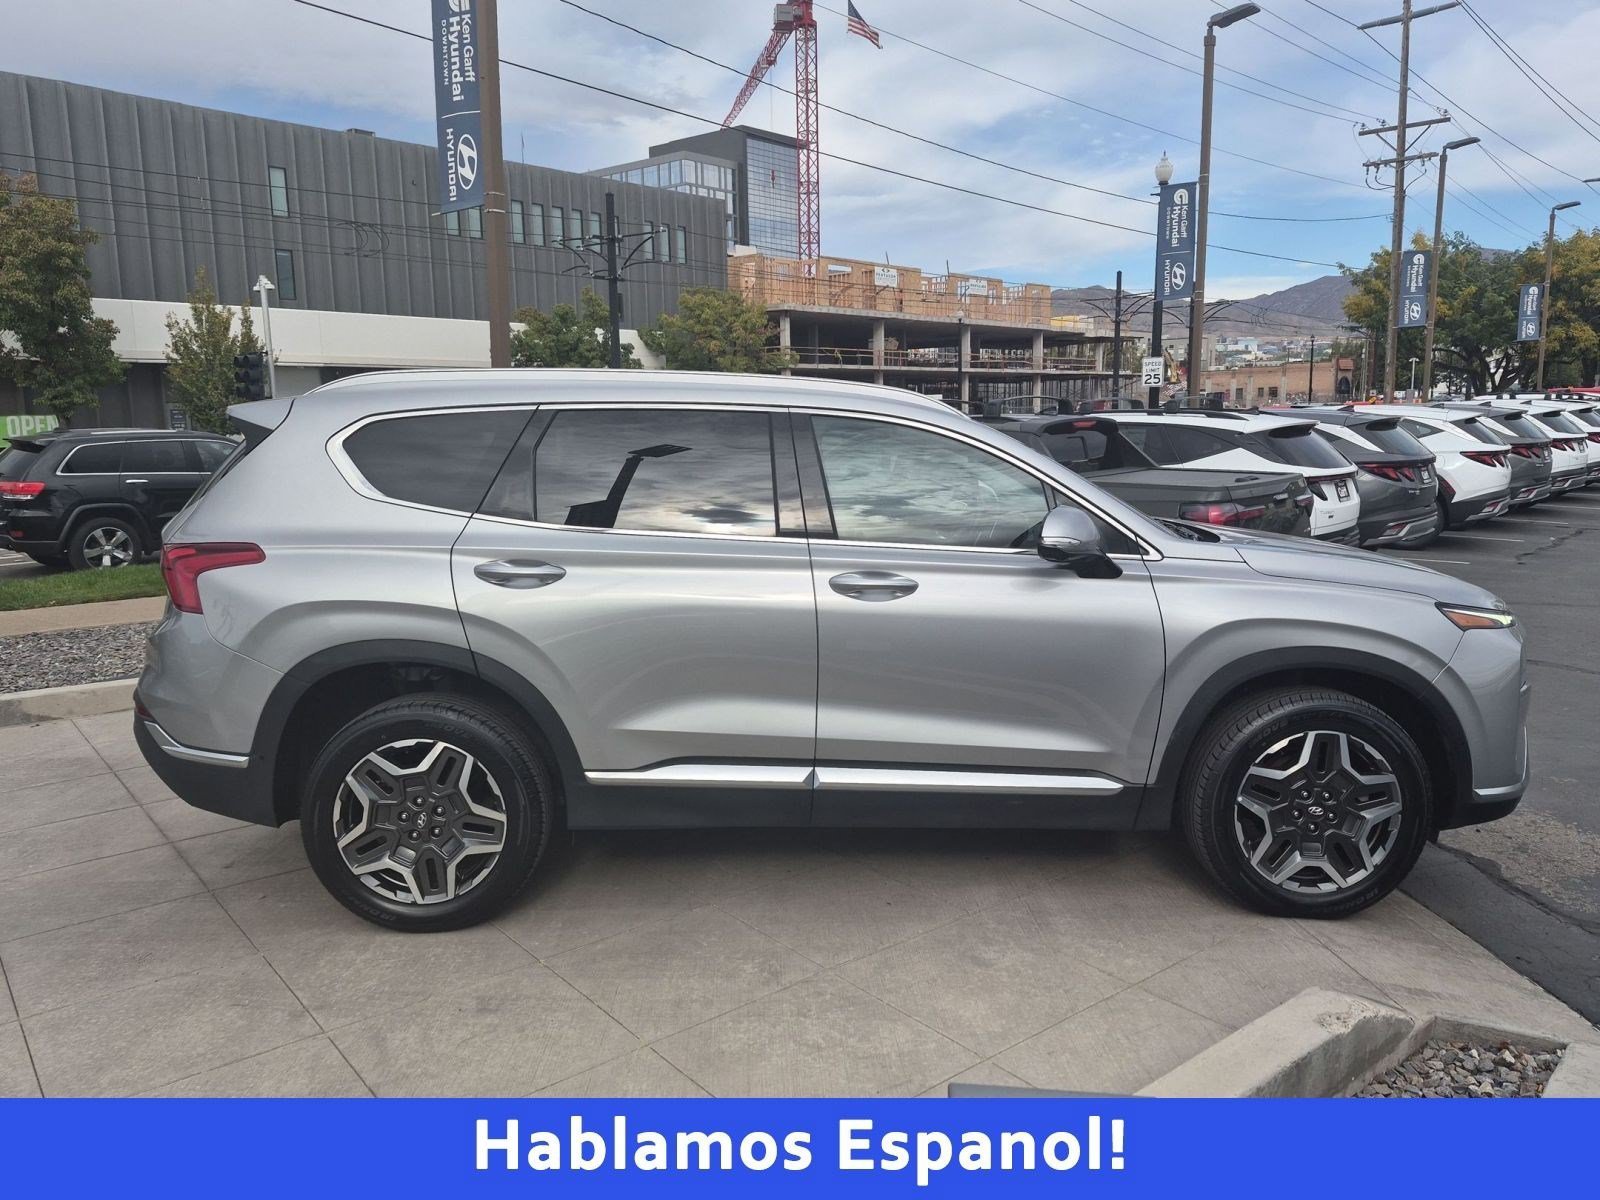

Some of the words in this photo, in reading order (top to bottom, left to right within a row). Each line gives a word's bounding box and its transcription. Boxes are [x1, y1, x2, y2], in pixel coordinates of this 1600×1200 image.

[462, 14, 472, 44] Ken
[448, 16, 464, 102] Hyundai
[464, 45, 475, 82] Garff
[446, 128, 457, 201] HYUNDAI
[1171, 206, 1181, 247] Hyundai
[1180, 205, 1188, 220] Ken
[1144, 374, 1160, 384] 25
[6, 414, 59, 438] OPEN
